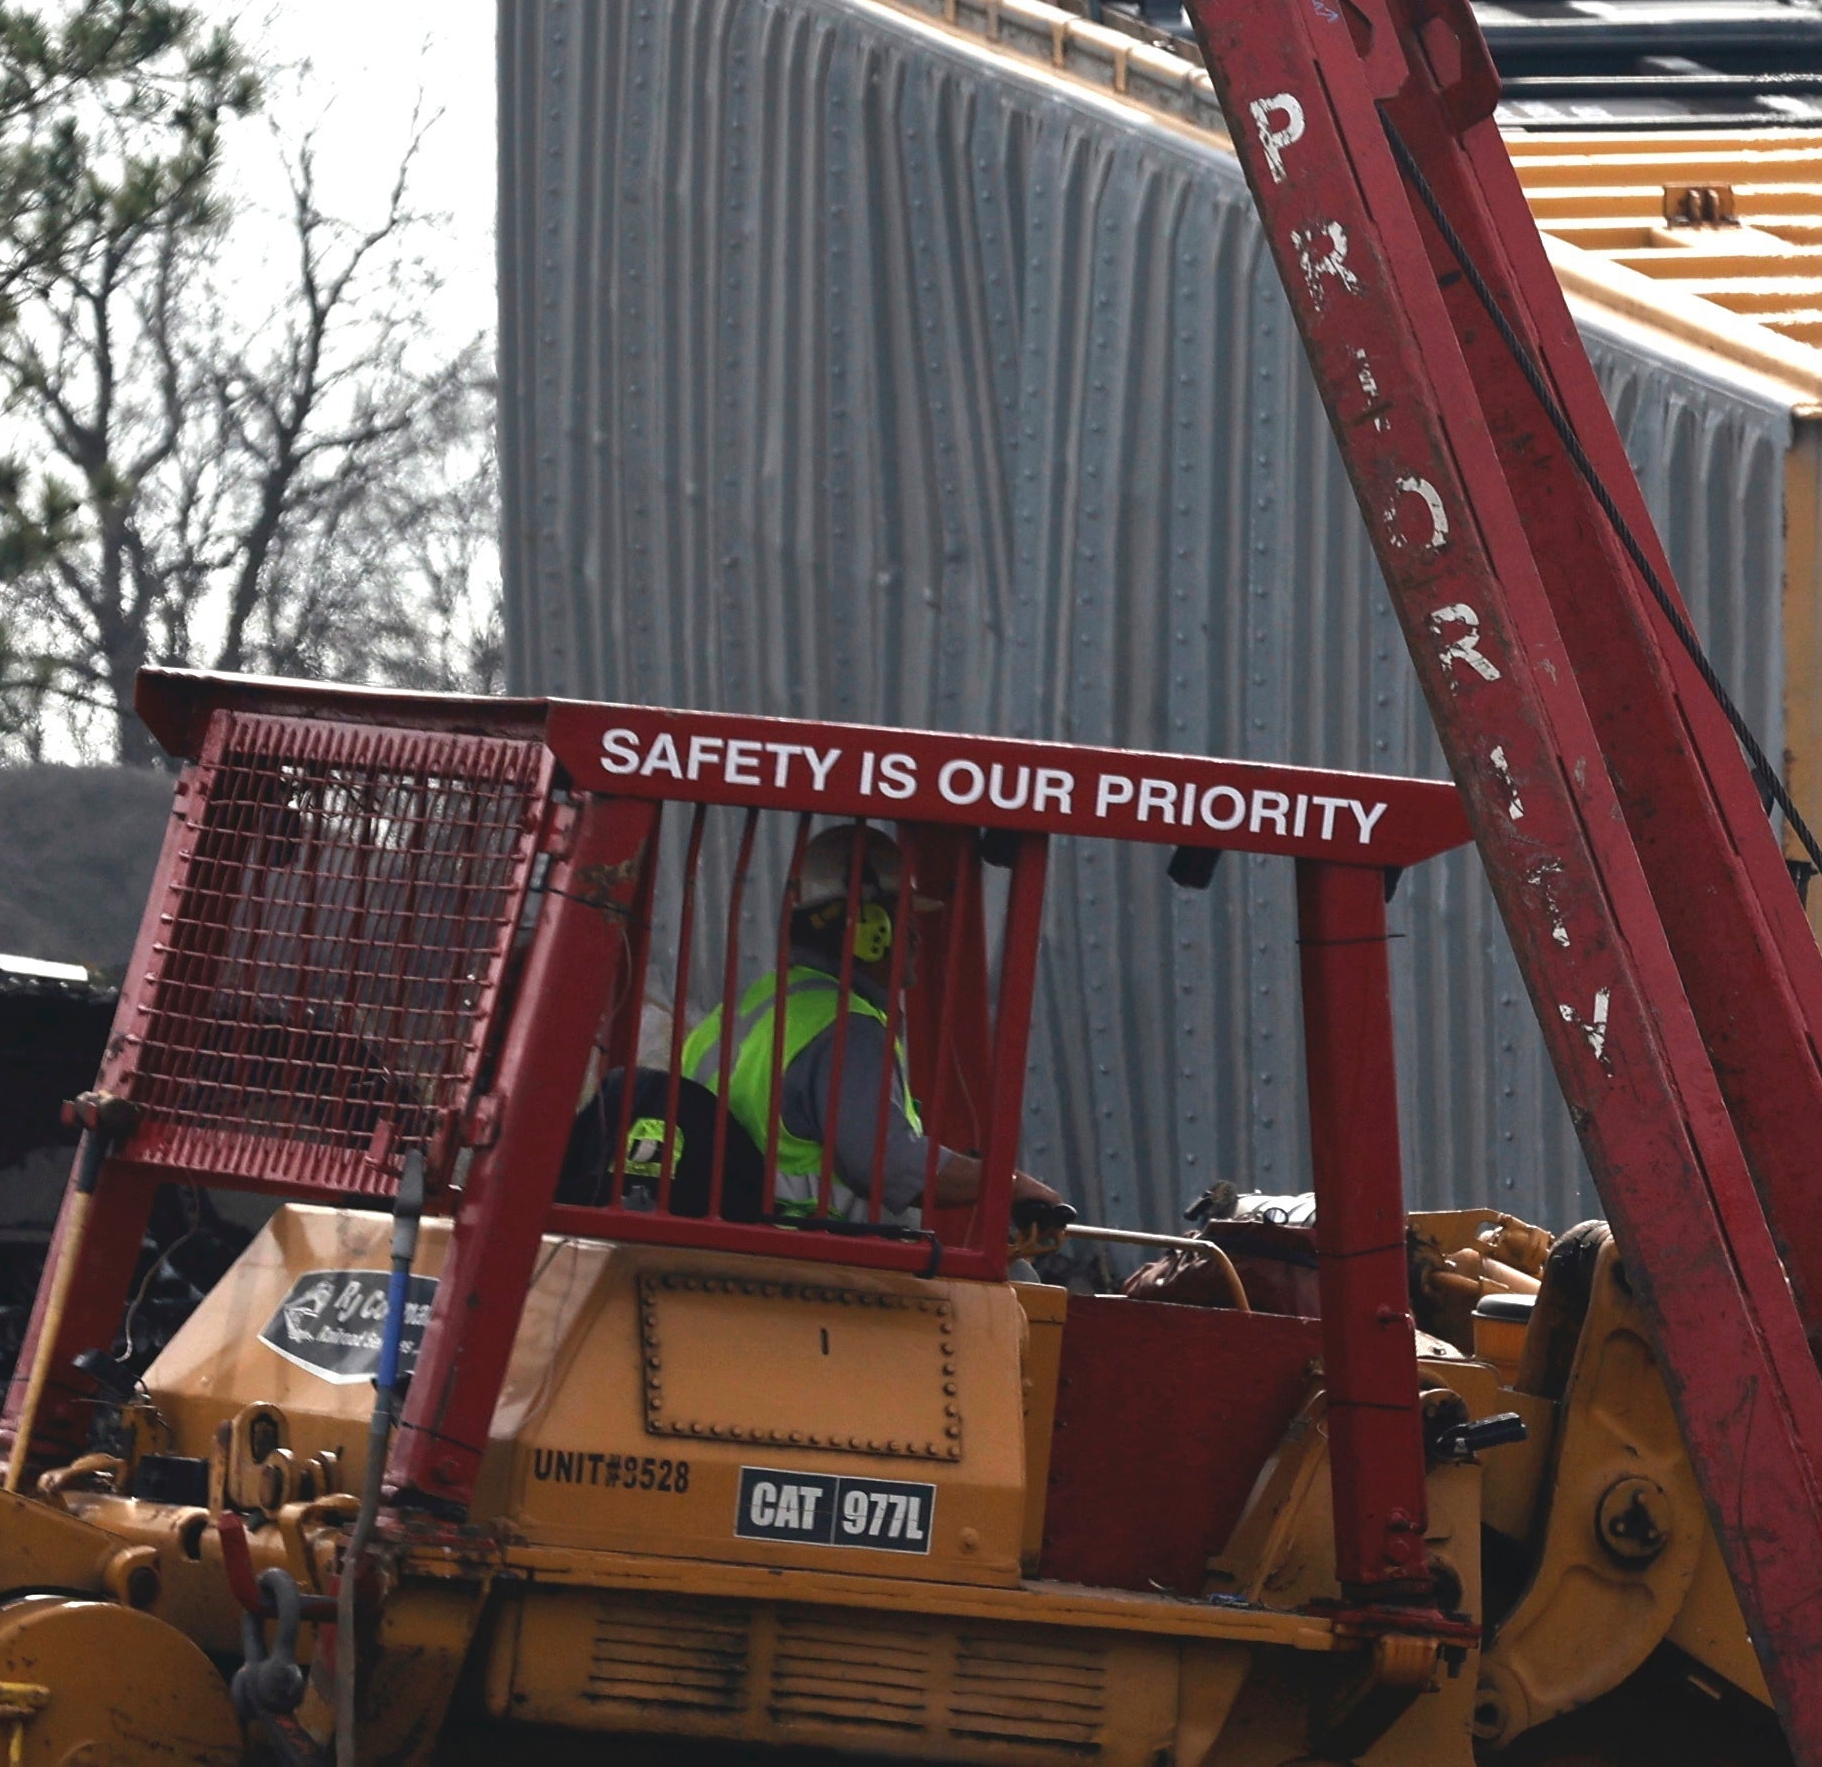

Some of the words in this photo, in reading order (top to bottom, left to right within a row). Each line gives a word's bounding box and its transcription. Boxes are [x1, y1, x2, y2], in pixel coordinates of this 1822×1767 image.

[599, 728, 842, 792] SAFETY
[859, 751, 918, 801] IS
[937, 758, 1076, 815] OUR
[1095, 774, 1388, 845] PRIORITY
[750, 1481, 824, 1531] CAT
[842, 1490, 924, 1540] 977L
